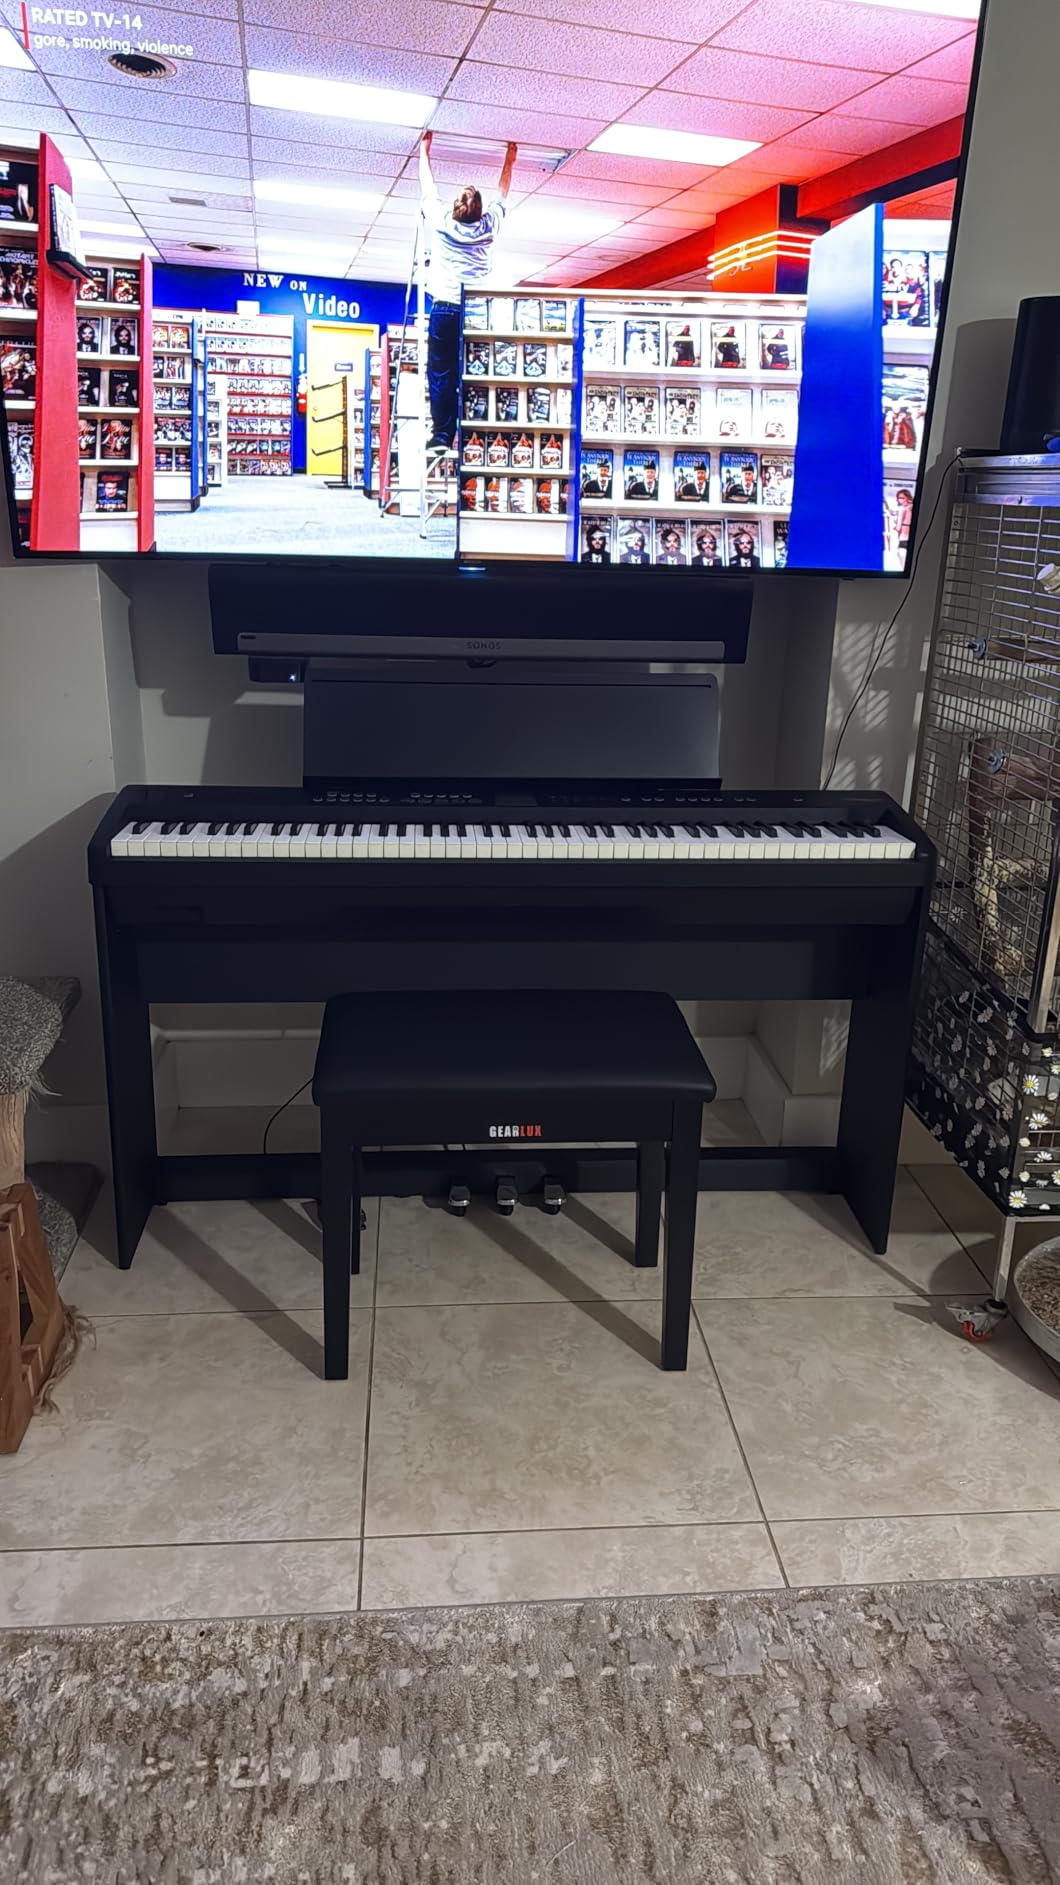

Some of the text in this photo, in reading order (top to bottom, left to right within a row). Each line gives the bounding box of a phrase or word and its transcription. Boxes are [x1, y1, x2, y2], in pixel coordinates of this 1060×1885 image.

[31, 8, 143, 31] RATED TV-14
[34, 34, 194, 56] gore, smoking, violence
[243, 272, 307, 291] NEW ON
[303, 293, 360, 319] Video
[466, 641, 502, 649] SONOS
[489, 1125, 542, 1137] GEARLUX
